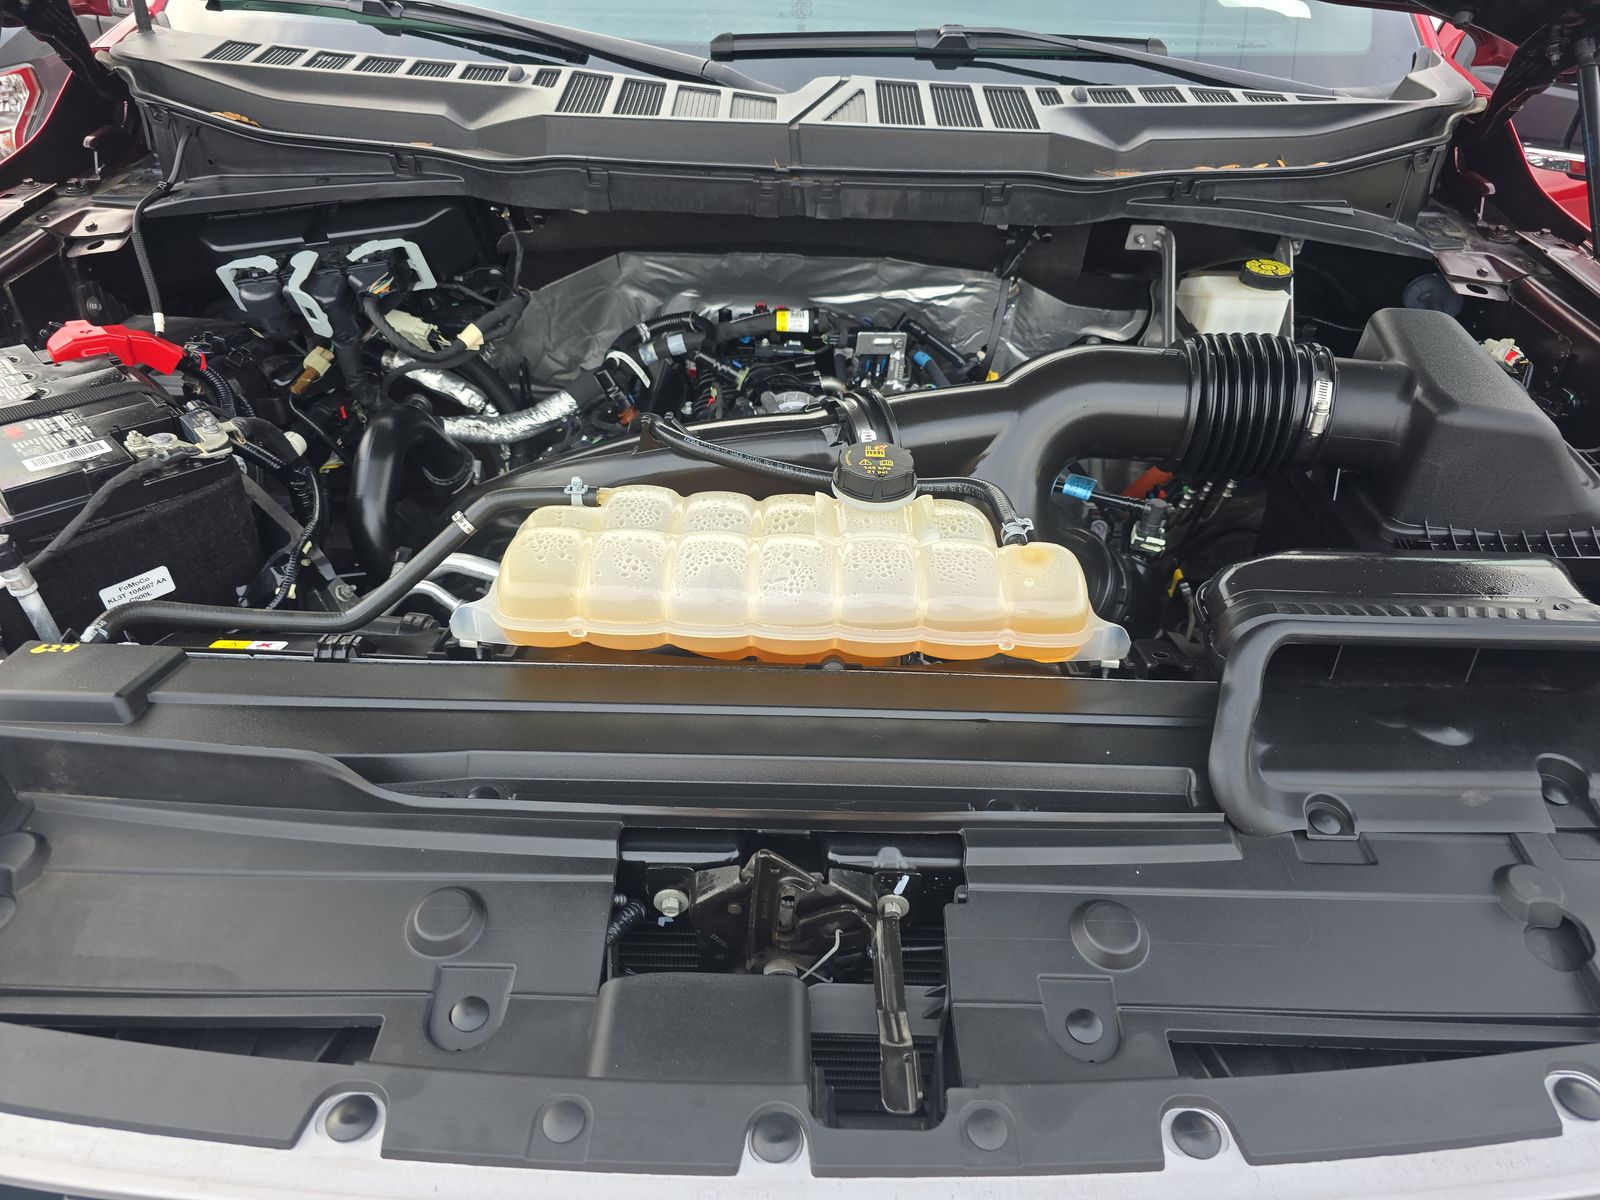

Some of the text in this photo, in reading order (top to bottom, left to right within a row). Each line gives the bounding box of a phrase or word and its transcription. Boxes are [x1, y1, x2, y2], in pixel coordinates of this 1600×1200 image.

[107, 592, 127, 605] KL3T
[156, 577, 167, 586] AA
[118, 577, 150, 592] FoMoCo
